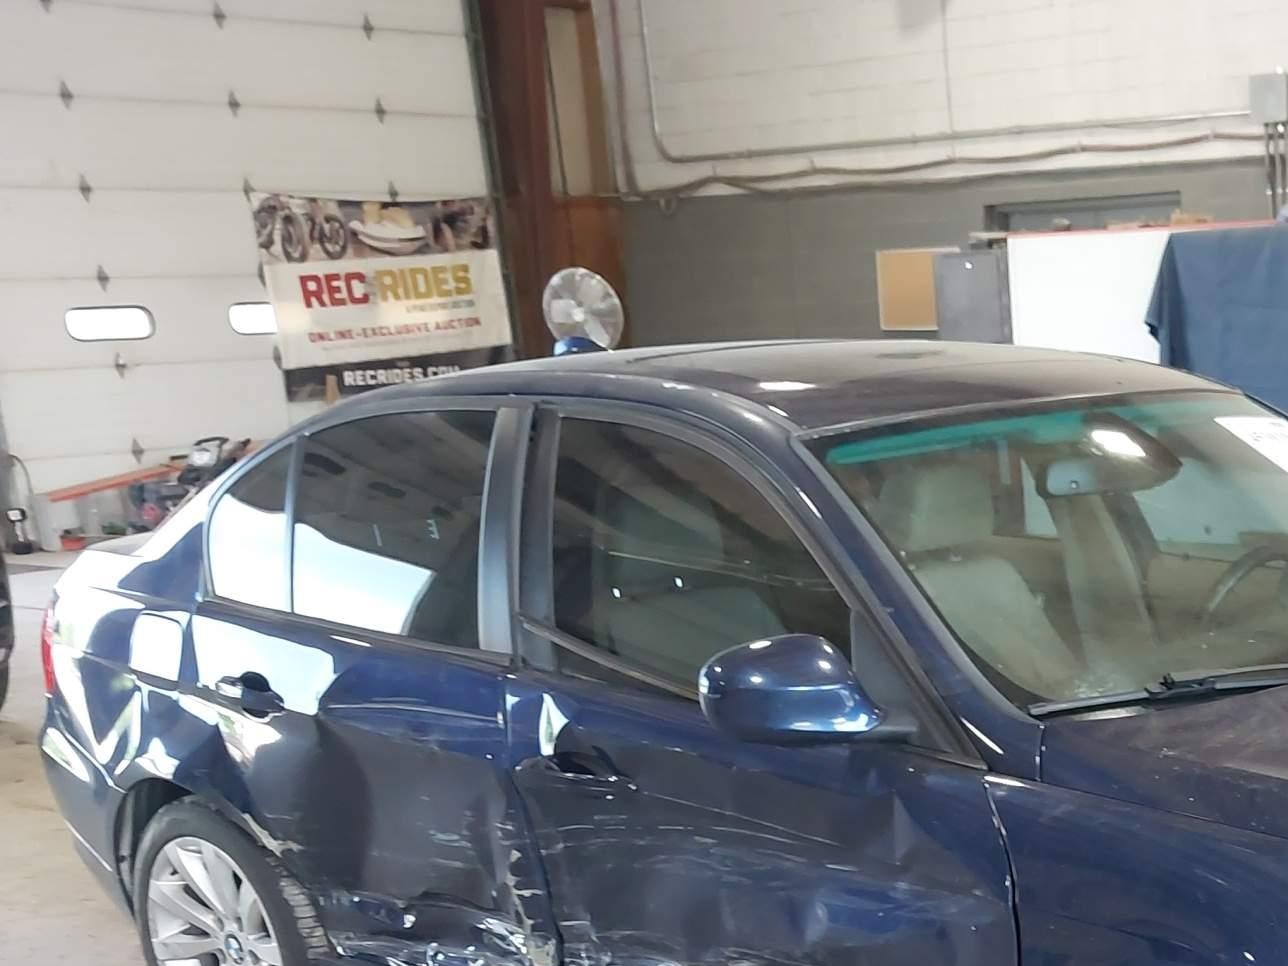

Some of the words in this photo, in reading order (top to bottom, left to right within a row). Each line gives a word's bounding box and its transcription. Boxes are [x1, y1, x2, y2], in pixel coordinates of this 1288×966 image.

[299, 271, 370, 308] REC
[374, 263, 474, 302] RIDES
[307, 322, 431, 342] ONLINE-EXCLUSIVE
[435, 317, 481, 331] AUCTION
